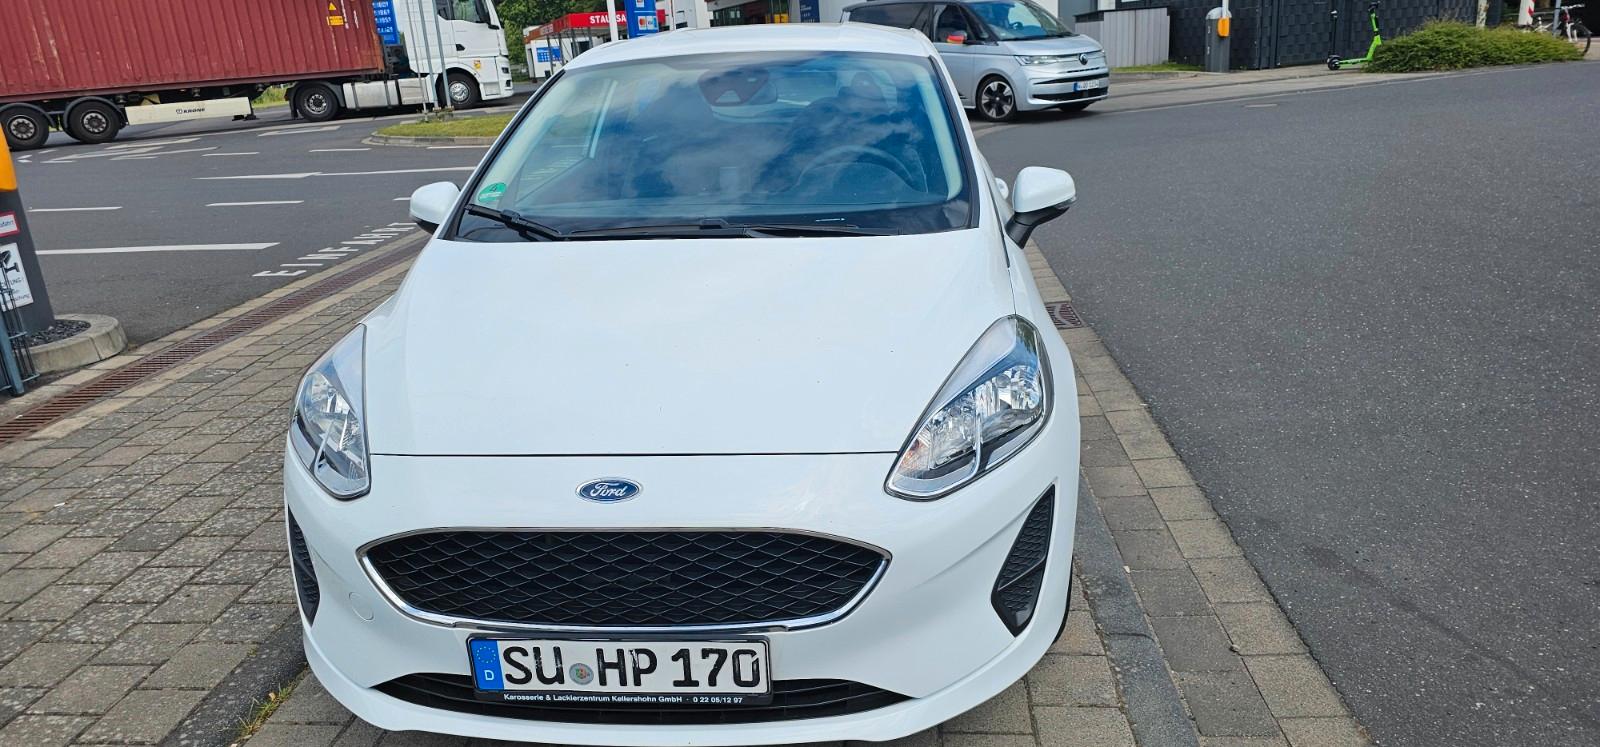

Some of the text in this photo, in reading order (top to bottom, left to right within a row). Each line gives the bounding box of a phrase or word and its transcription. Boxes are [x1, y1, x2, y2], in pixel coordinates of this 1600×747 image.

[590, 482, 628, 497] Ford
[503, 646, 760, 687] SU HP 170
[484, 669, 495, 681] D
[503, 693, 544, 701] Karosserie
[553, 694, 610, 702] Lackierzentrum
[611, 695, 657, 703] Kellershohn
